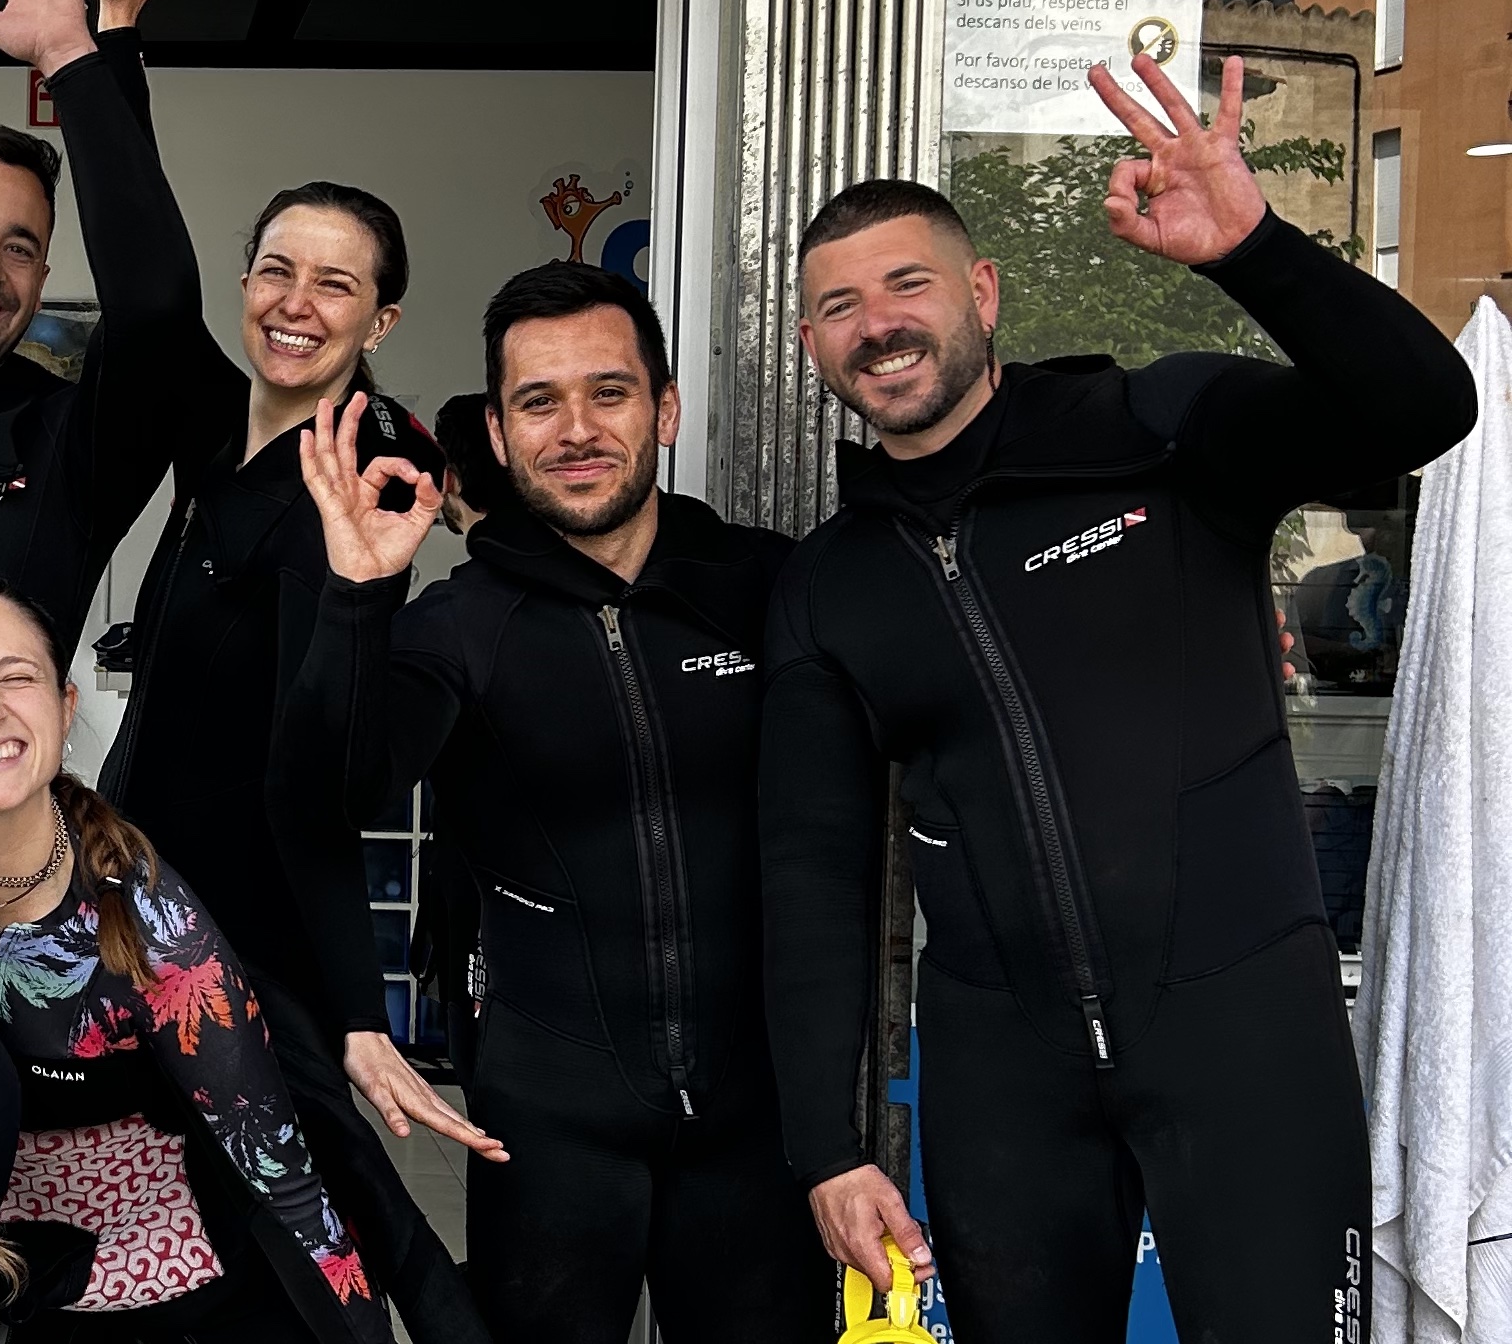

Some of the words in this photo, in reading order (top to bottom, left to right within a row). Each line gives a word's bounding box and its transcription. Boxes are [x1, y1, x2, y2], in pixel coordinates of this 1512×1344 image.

[956, 13, 1020, 30] descans
[1024, 15, 1056, 30] dels
[955, 53, 982, 67] Por
[987, 52, 1029, 71] favor,
[1034, 56, 1093, 71] respeta
[954, 74, 1028, 90] descanso
[1032, 75, 1052, 90] de
[1057, 76, 1079, 91] los
[1024, 517, 1122, 572] CRESSI
[31, 1064, 85, 1082] OLAIAN
[1334, 1288, 1346, 1324] dive
